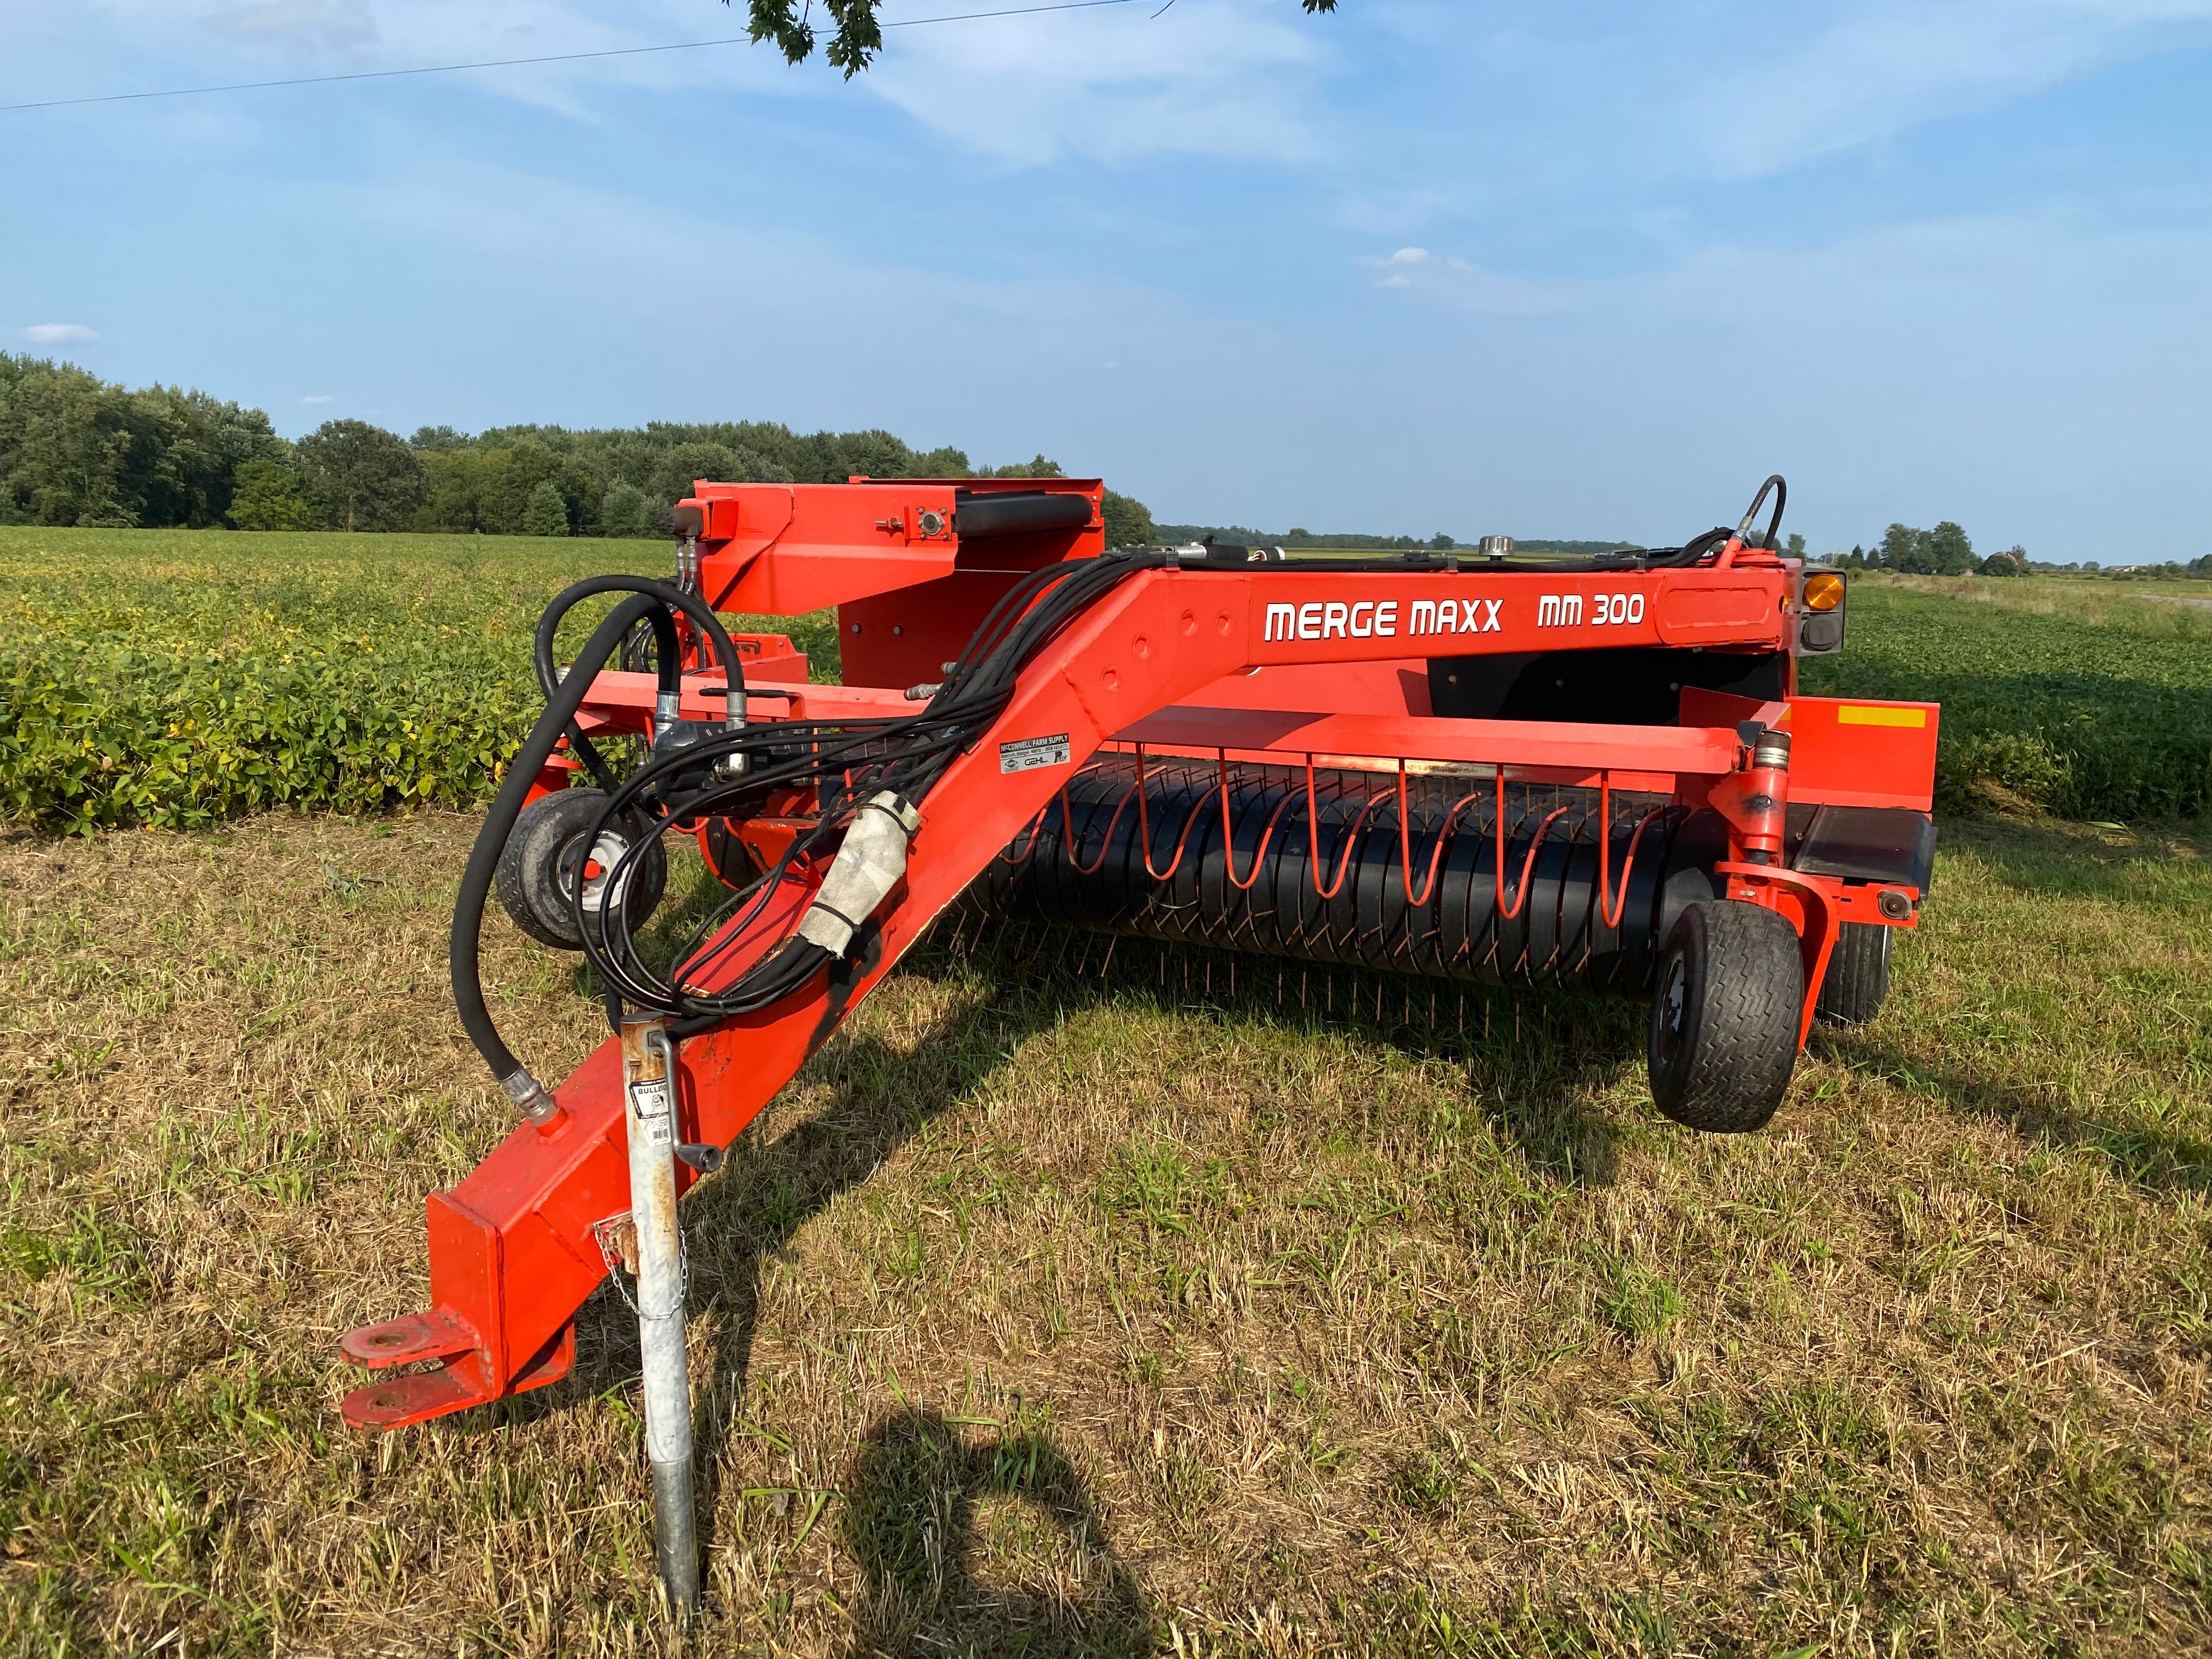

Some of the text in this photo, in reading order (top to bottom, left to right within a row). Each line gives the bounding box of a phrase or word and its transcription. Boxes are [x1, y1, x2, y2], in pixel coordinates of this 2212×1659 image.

[1264, 592, 1645, 642] MERGE MAXX MM 300
[1048, 735, 1068, 743] SUPPLY
[1025, 757, 1047, 766] GEHL
[638, 1085, 667, 1094] BULLDO
